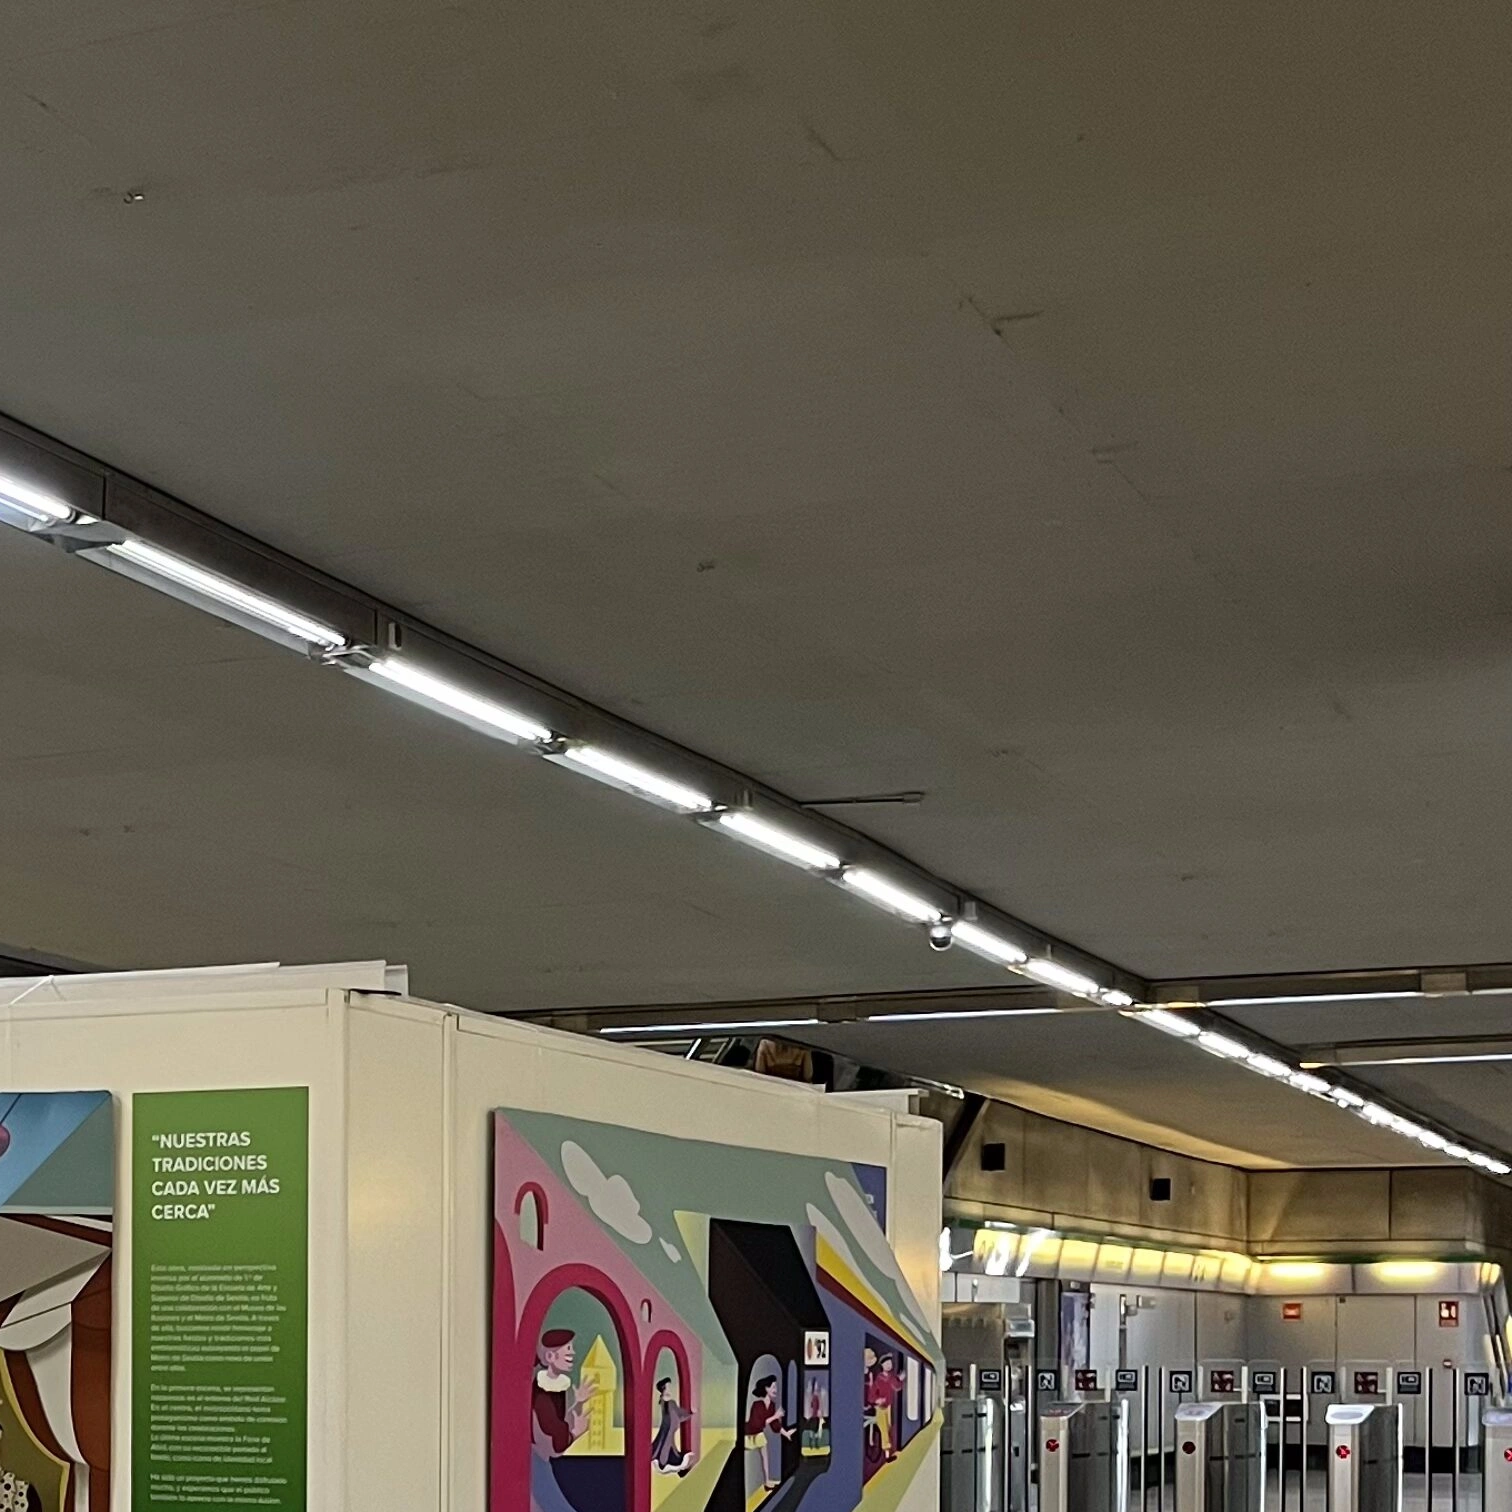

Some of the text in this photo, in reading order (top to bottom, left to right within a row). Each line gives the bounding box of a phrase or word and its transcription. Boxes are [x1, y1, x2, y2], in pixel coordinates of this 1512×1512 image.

[151, 1155, 268, 1172] TRADICIONES
[151, 1175, 280, 1196] CADA VEZ MÁS
